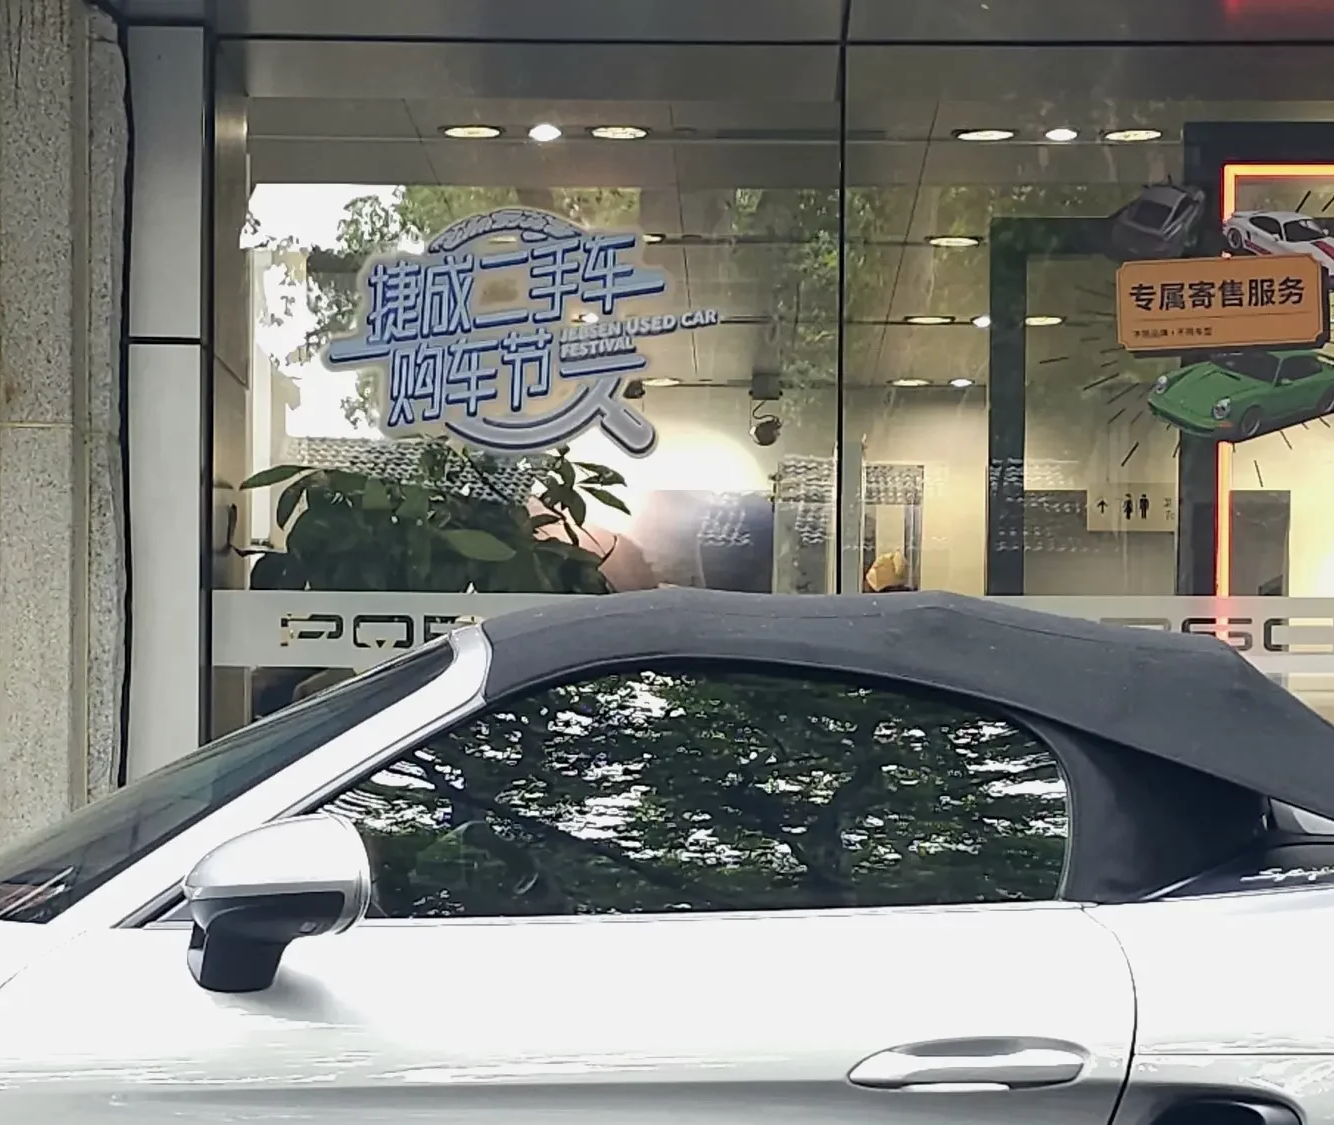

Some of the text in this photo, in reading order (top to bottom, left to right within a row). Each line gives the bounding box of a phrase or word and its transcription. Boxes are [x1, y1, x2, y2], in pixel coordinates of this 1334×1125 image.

[367, 234, 664, 343] 捷成二手车
[1129, 276, 1305, 311] 专属寄售服务
[560, 308, 720, 344] JEBSEN USED CAR
[560, 338, 636, 361] FESTIVAL
[388, 328, 554, 427] 购车节
